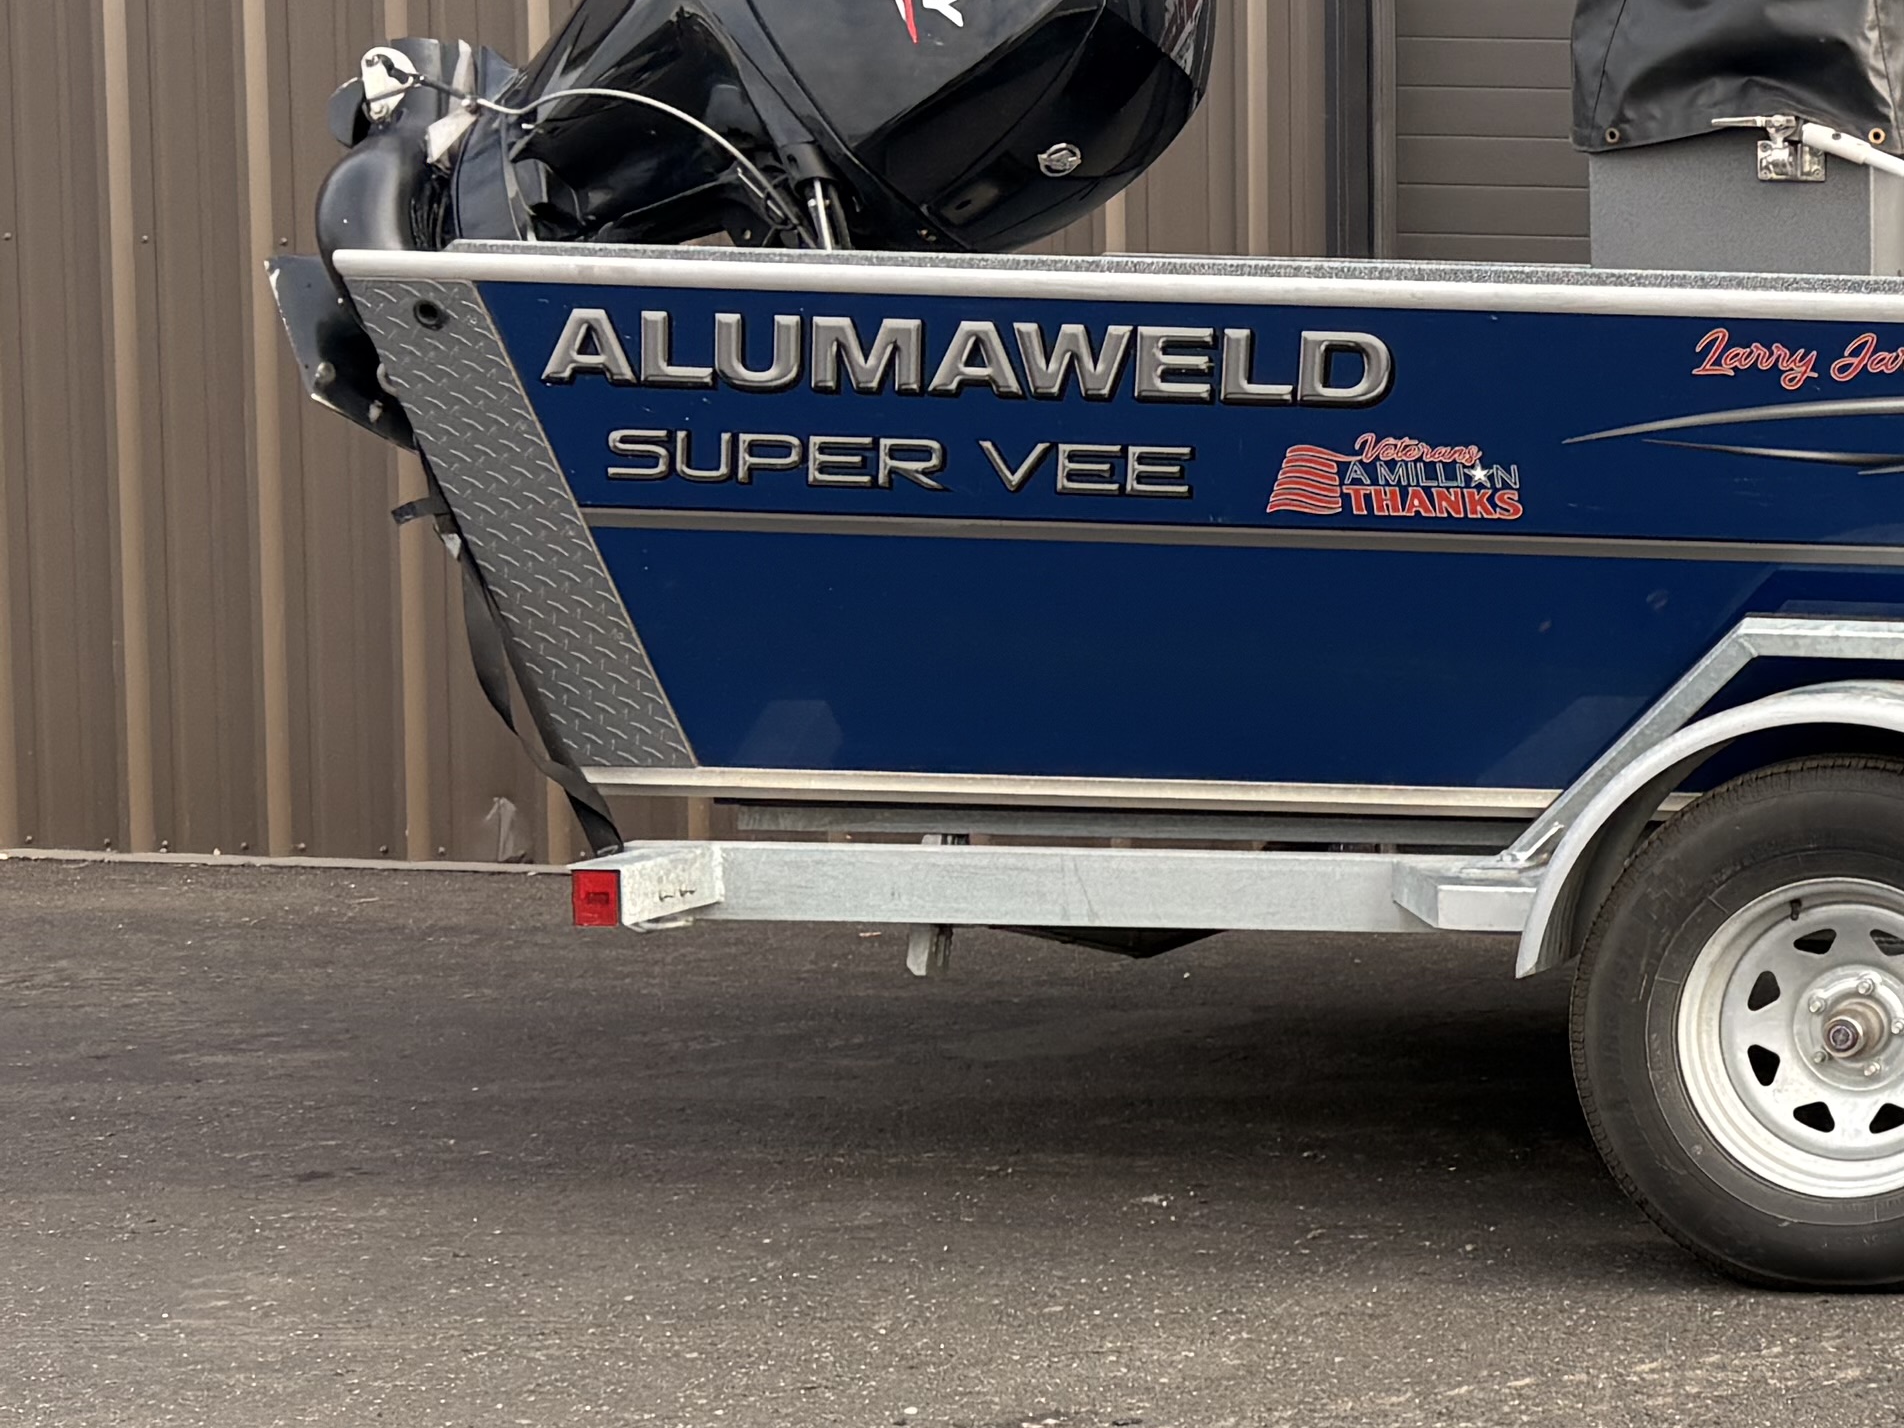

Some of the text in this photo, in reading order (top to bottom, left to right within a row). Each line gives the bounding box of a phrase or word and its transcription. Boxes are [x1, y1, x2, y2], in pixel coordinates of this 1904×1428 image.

[541, 307, 1394, 407] ALUMAWELD
[1692, 327, 1818, 390] Larry
[606, 428, 1196, 500] SUPER VEE
[1354, 432, 1483, 466] Veterans
[1344, 460, 1520, 489] A MILLIN
[1342, 485, 1524, 520] THANKS
